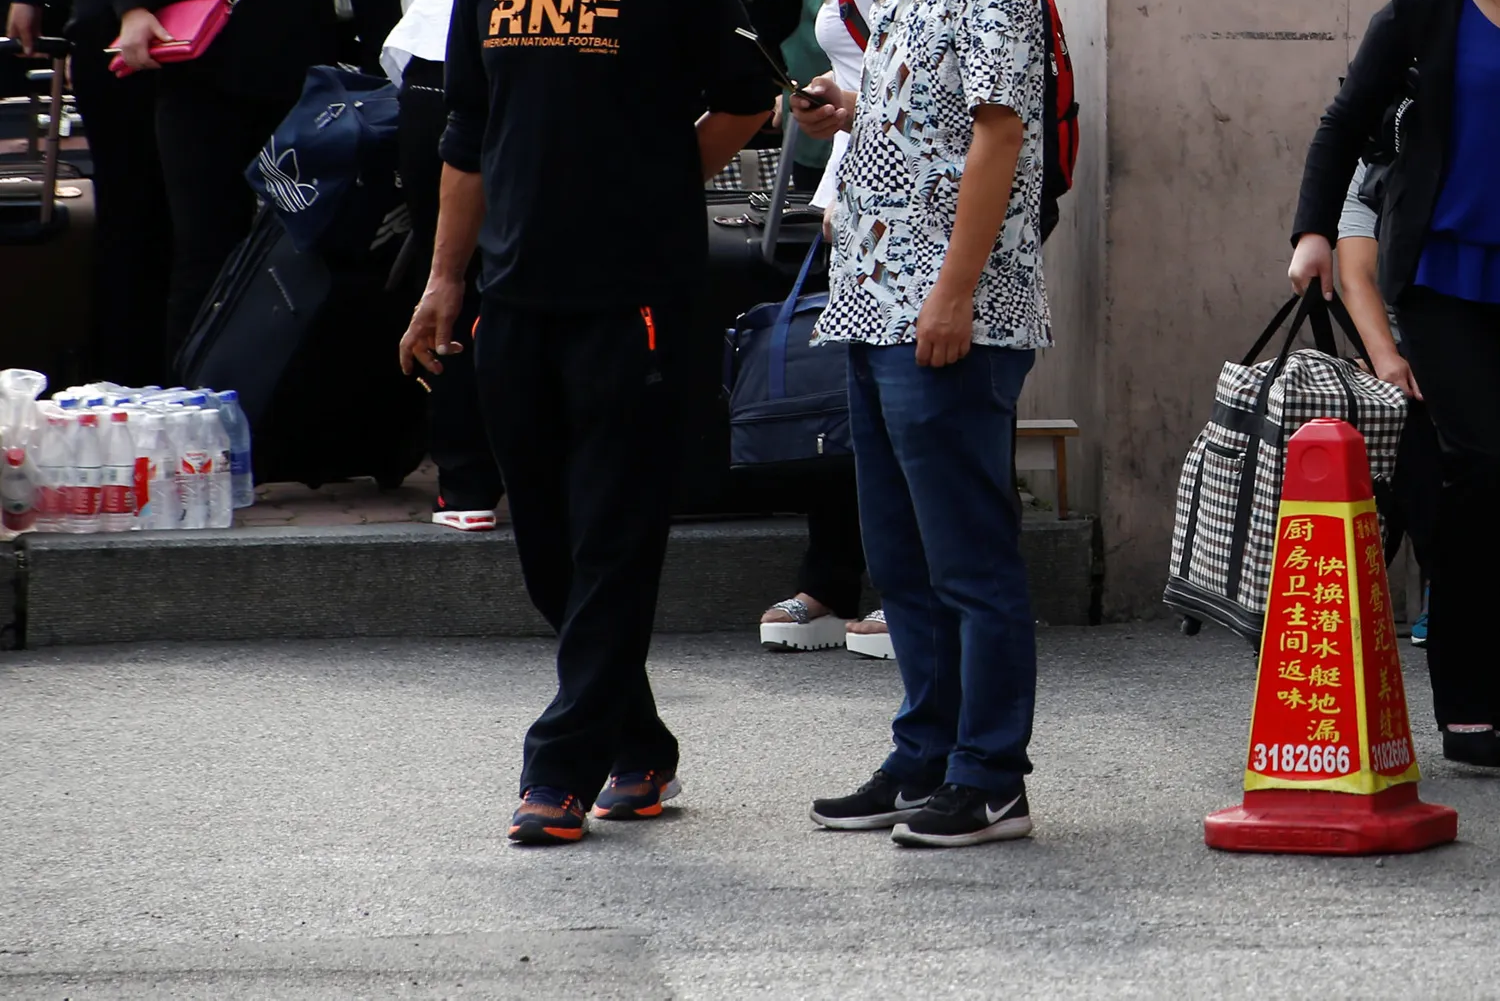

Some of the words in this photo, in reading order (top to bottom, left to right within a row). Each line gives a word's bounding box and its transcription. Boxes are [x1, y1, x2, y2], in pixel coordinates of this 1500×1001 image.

[520, 37, 565, 47] NATIONAL
[567, 37, 620, 49] FOOTBALL
[1277, 518, 1314, 710] 厨房卫生间返味
[1307, 556, 1346, 743] 快换潜水艇地漏
[1254, 743, 1350, 774] 3182666
